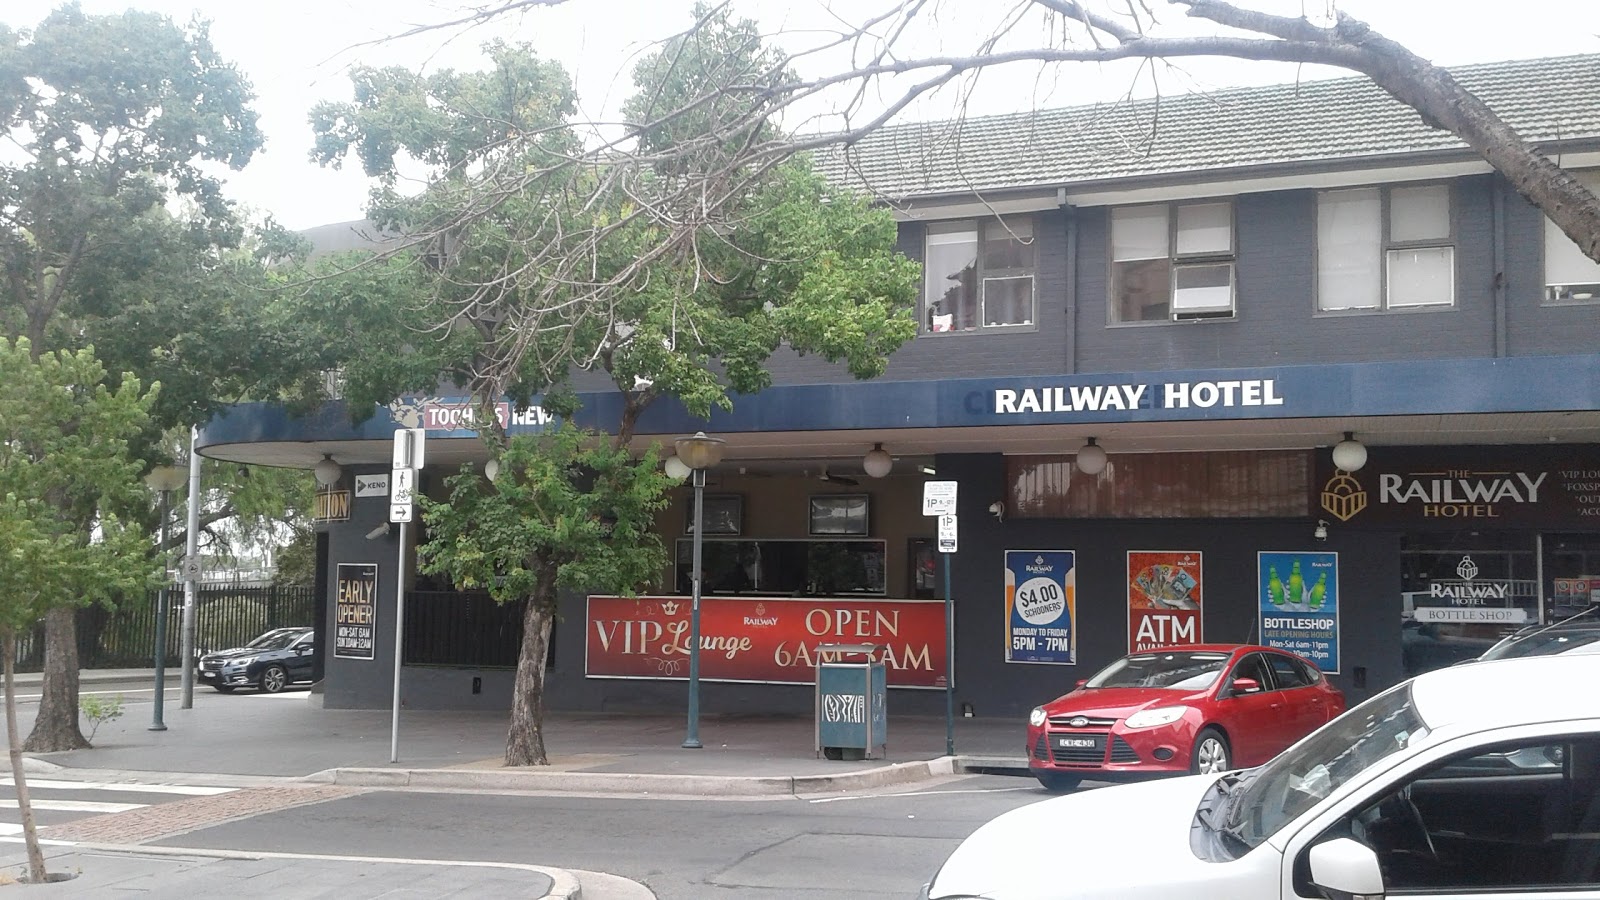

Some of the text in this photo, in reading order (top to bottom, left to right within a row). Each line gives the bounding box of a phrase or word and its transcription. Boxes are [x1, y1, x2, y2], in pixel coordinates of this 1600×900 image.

[995, 384, 1147, 414] RAILWAY
[1164, 379, 1284, 409] HOTEL
[1448, 470, 1470, 479] THE
[1561, 470, 1580, 479] VIP
[367, 481, 386, 489] KENO
[1380, 472, 1548, 504] RAILWAY
[1423, 505, 1500, 517] HOTEL
[338, 579, 374, 604] EARLY
[1020, 584, 1058, 608] $4.00
[1430, 583, 1509, 599] RAILWAY
[1451, 598, 1488, 606] HOTEL
[337, 604, 373, 625] OPENER
[743, 616, 779, 626] RAILWAY
[1429, 610, 1513, 621] BOTTLE SHOP
[805, 608, 900, 637] OPEN
[1135, 614, 1195, 643] ATM
[1264, 617, 1335, 630] BOTTLESHOP
[593, 620, 663, 655] VIP
[1013, 627, 1068, 637] MONDAY TO FRIDAY
[1264, 630, 1334, 639] LATE OPENING HOURS
[1013, 637, 1036, 651] 5PM
[1045, 638, 1068, 652] 7PM
[1269, 640, 1295, 648] Mon-Sat
